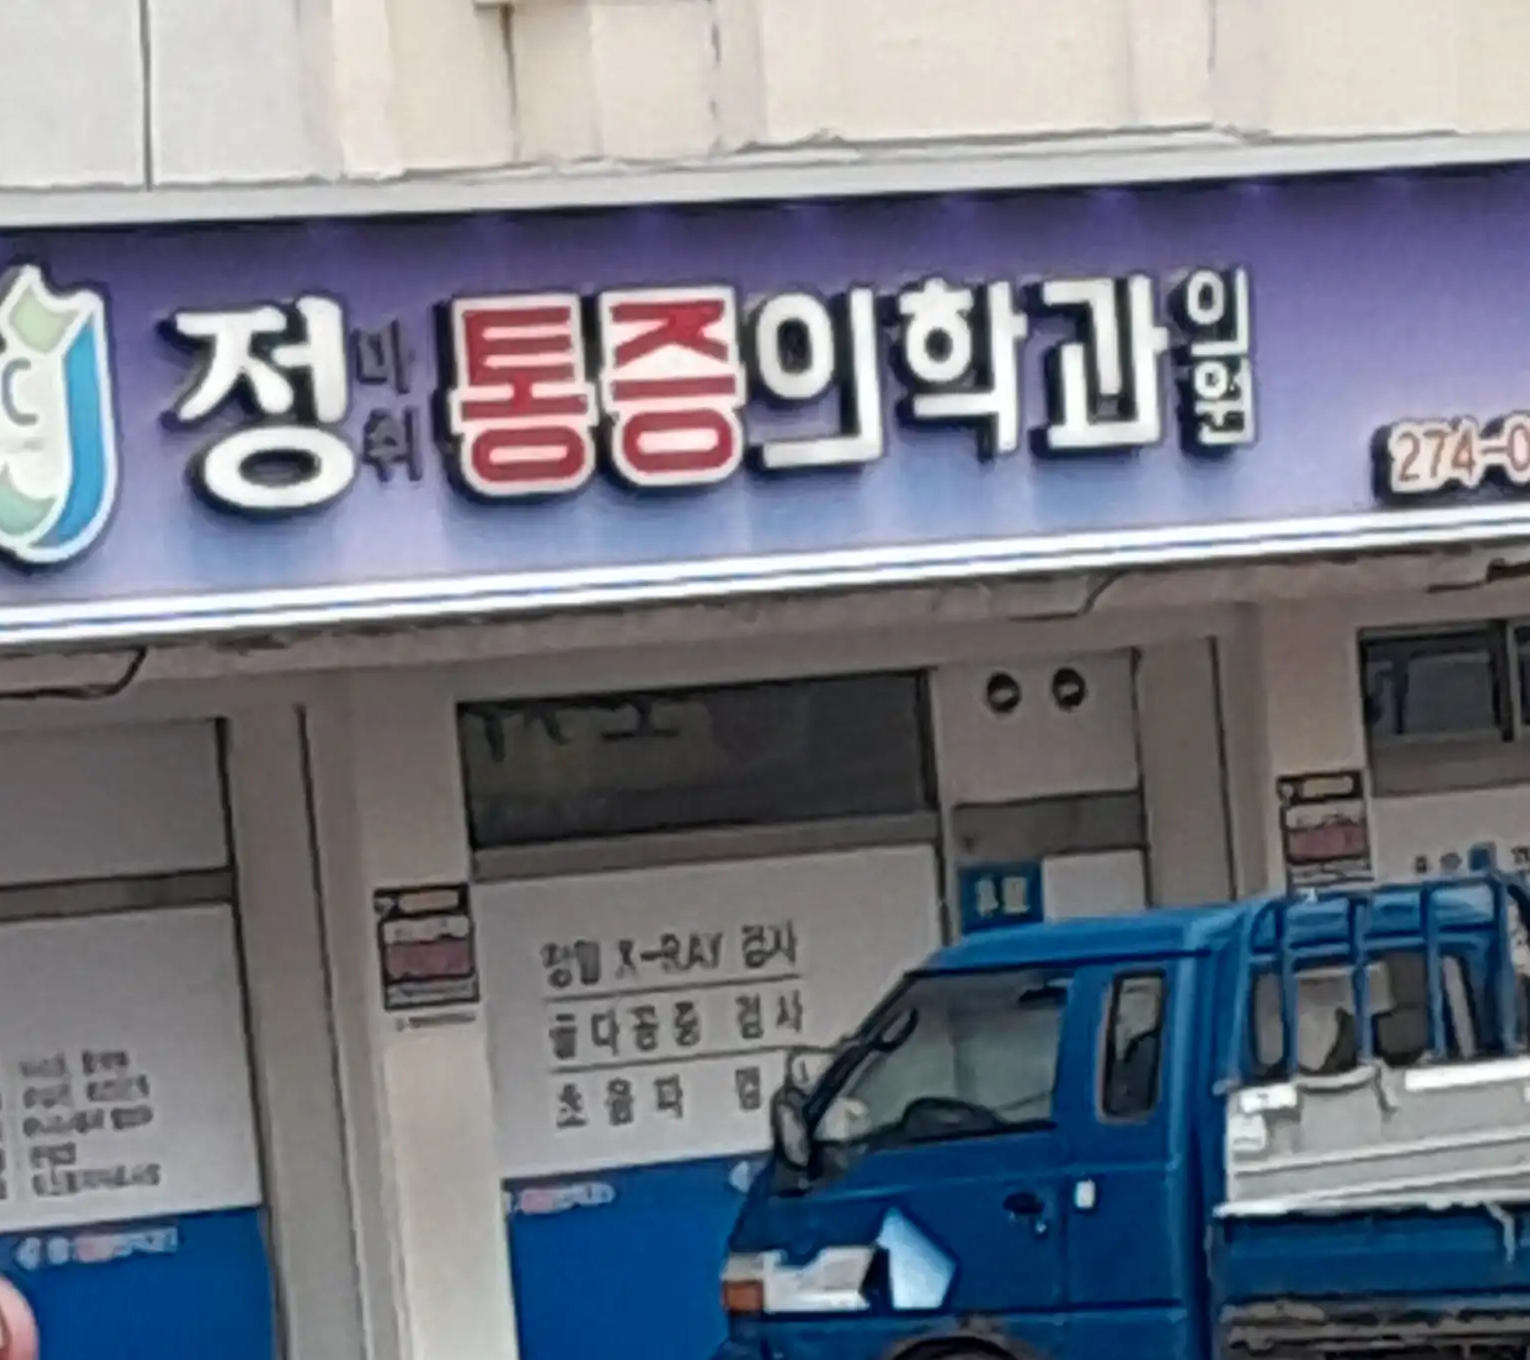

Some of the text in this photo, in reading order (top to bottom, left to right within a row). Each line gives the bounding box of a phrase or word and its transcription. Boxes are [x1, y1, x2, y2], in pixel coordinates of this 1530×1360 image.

[174, 295, 356, 508] 정
[448, 270, 1168, 498] 통증의학과
[616, 930, 723, 980] X-RAY
[740, 918, 798, 970] 검사
[734, 988, 804, 1040] 검사
